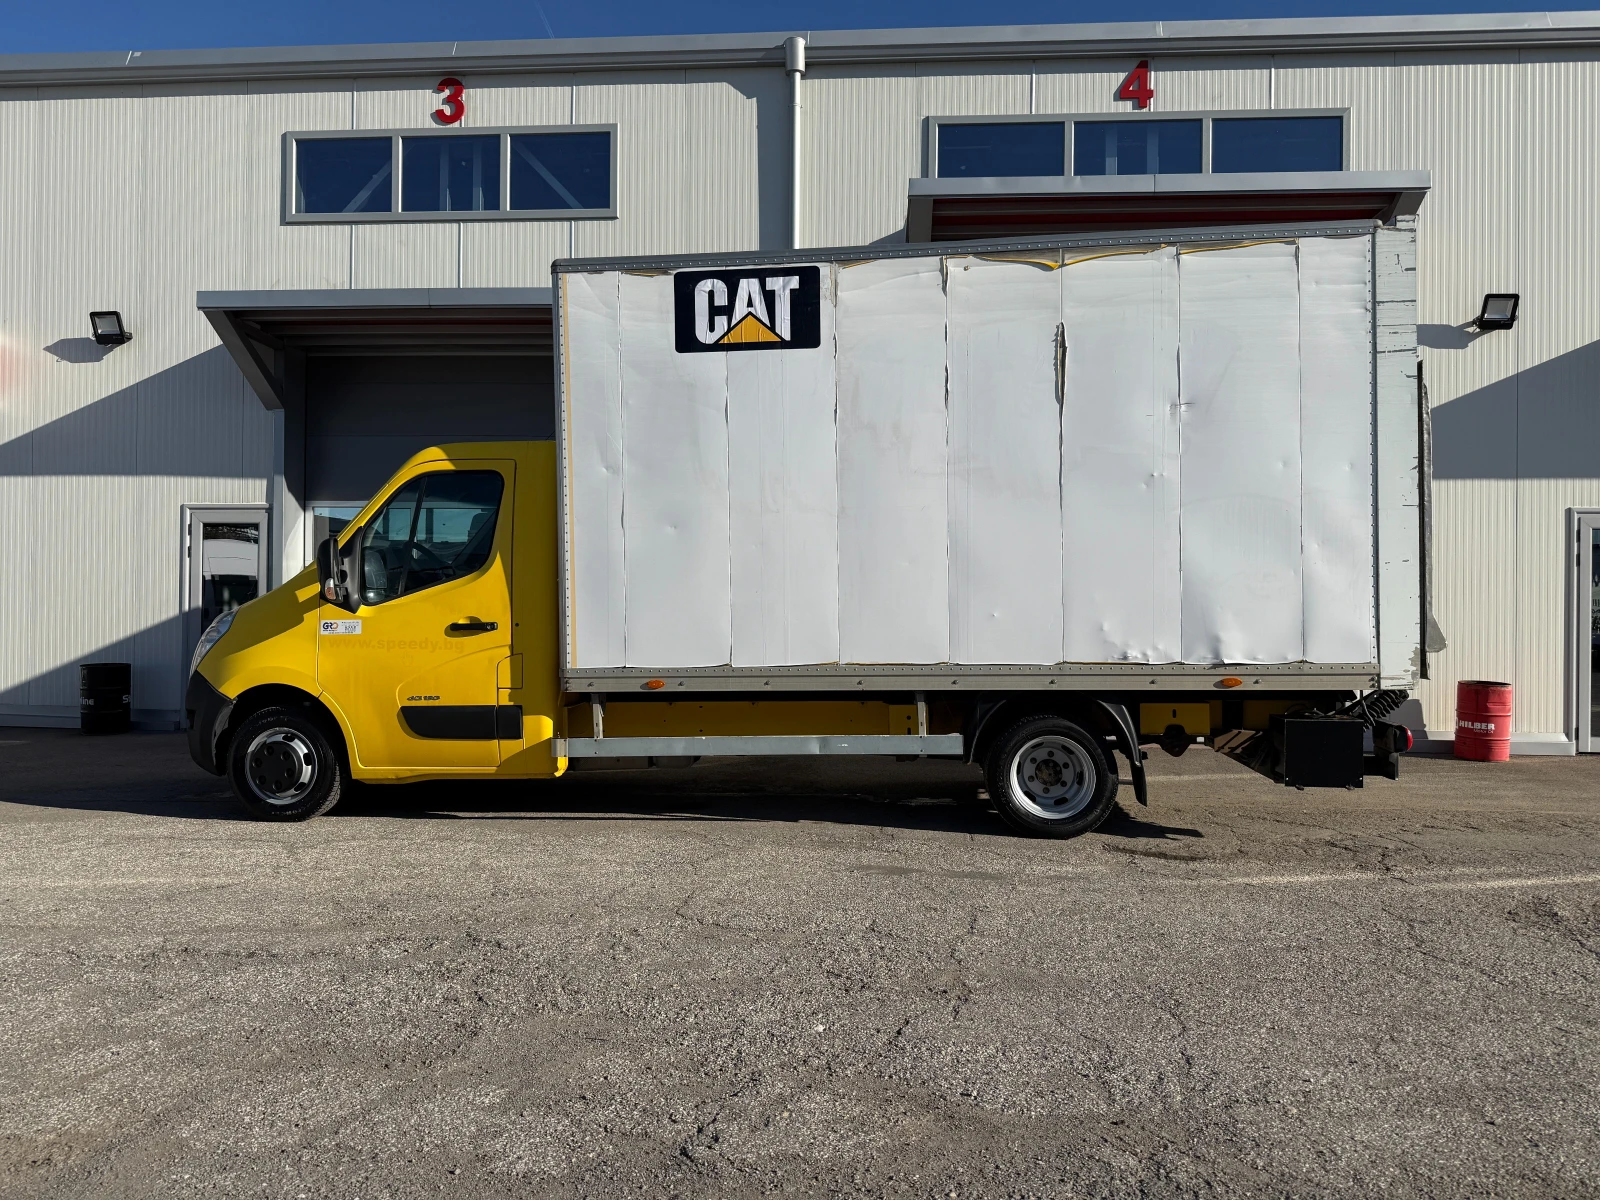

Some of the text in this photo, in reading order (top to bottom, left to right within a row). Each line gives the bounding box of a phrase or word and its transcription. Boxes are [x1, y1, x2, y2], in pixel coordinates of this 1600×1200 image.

[435, 77, 465, 124] 3
[1119, 60, 1154, 108] 4
[695, 276, 799, 344] CAT
[328, 637, 465, 653] www.speedy.bg
[1459, 720, 1495, 730] HILBER
